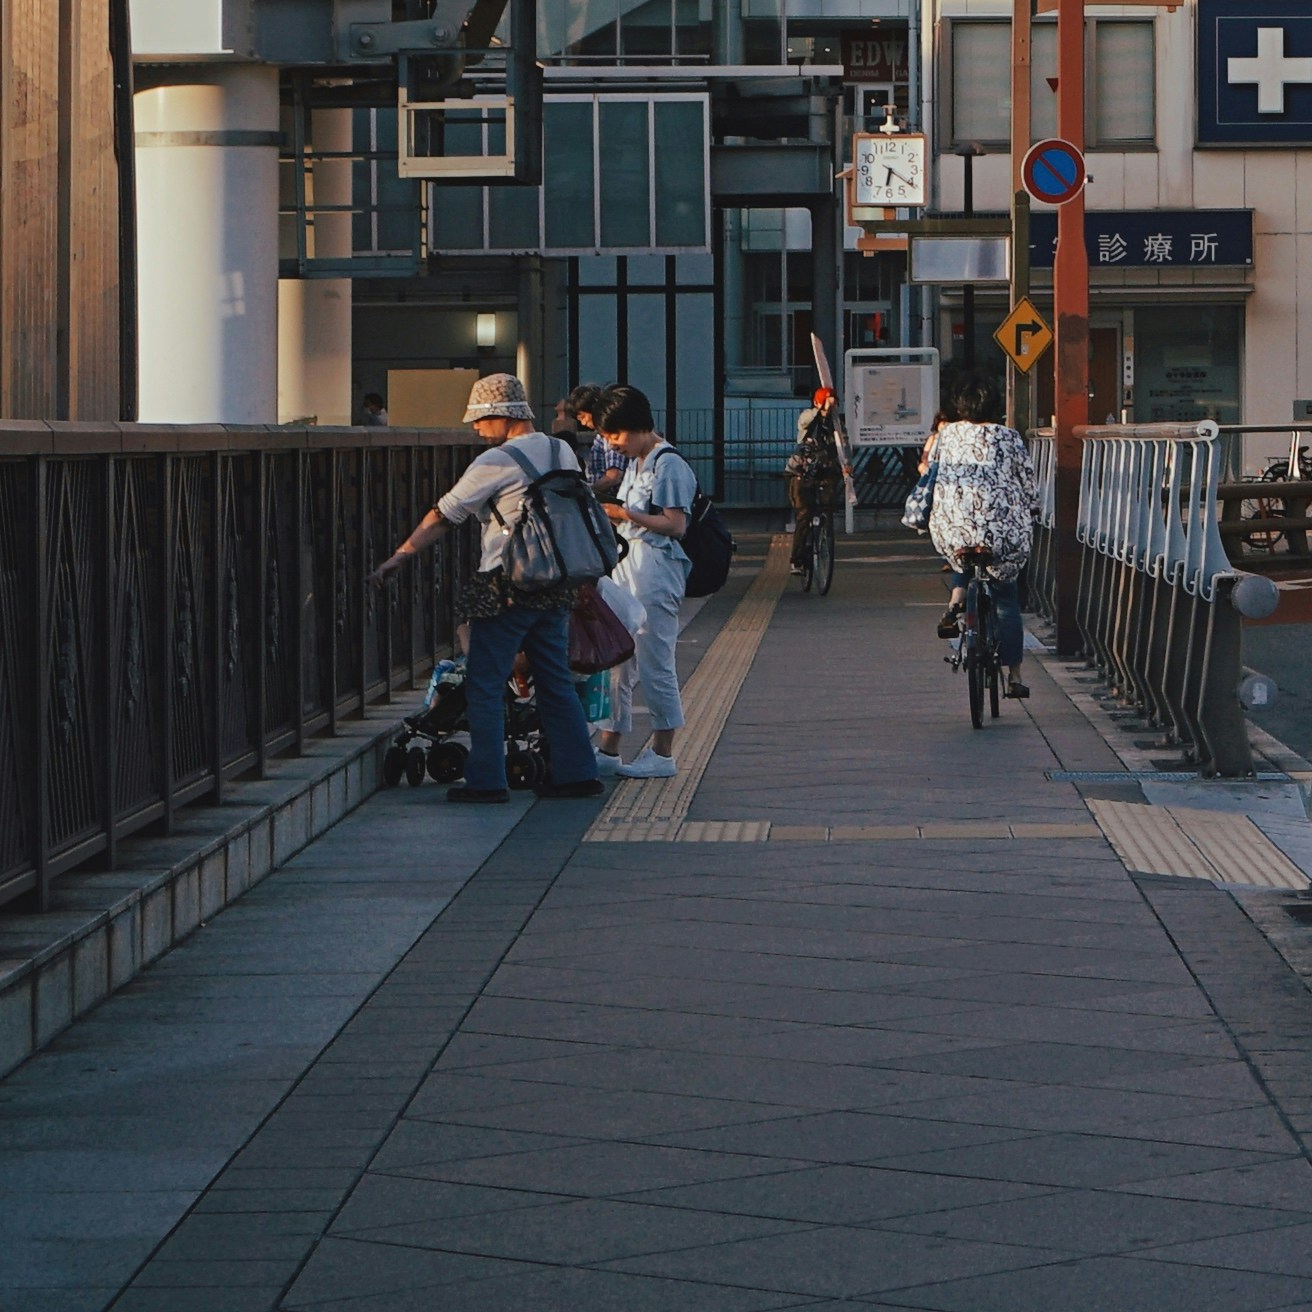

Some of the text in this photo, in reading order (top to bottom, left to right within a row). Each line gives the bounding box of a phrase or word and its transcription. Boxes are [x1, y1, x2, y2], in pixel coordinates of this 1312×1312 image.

[885, 142, 896, 152] 12
[862, 153, 875, 164] 10
[908, 153, 915, 163] 2
[861, 166, 869, 175] 9
[910, 165, 919, 175] 3
[866, 176, 873, 186] 8
[874, 186, 882, 195] 7
[885, 188, 893, 198] 6
[898, 186, 906, 195] 5
